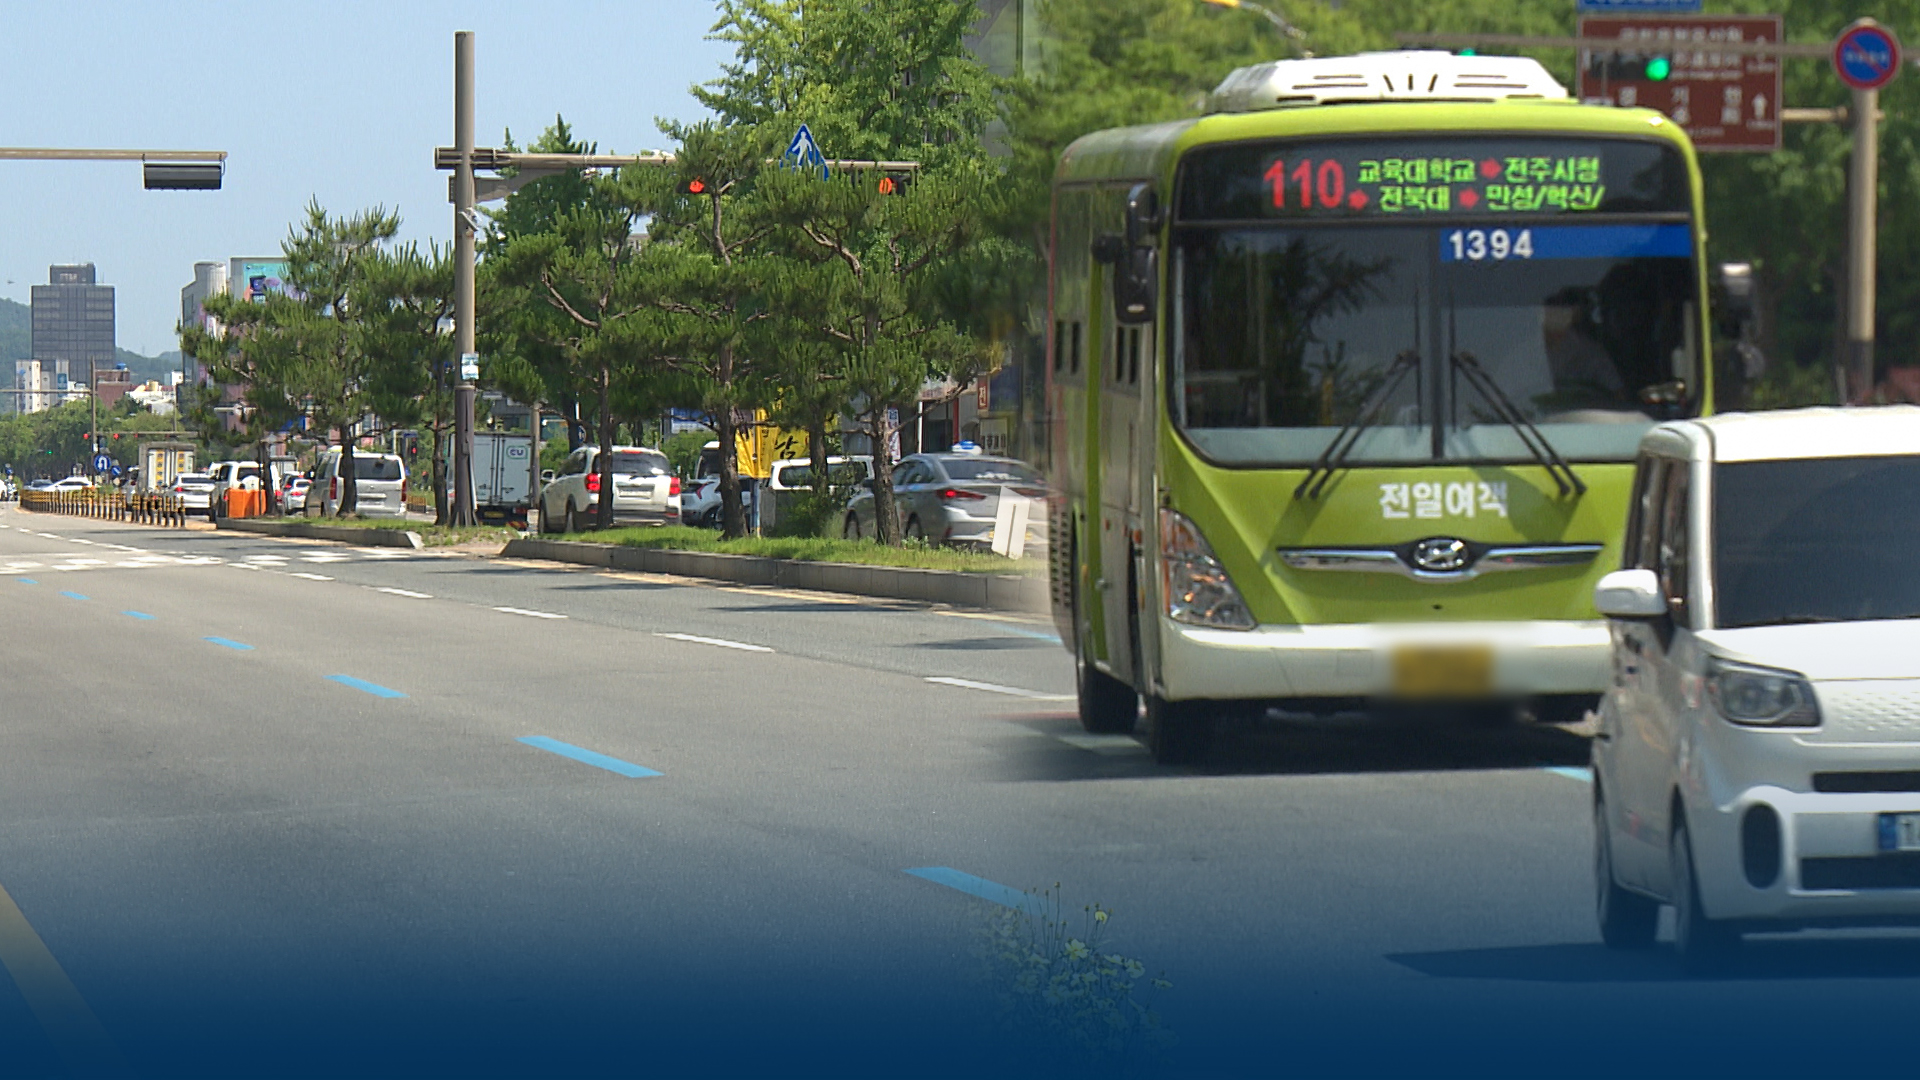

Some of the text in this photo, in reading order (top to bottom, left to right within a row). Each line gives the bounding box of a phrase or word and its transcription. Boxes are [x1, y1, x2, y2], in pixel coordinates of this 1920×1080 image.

[1264, 159, 1344, 208] 110
[1358, 157, 1601, 184] 교육대학교 전주시청
[1379, 185, 1451, 212] 전북대
[1449, 229, 1534, 260] 1394
[509, 448, 524, 456] CU
[1379, 481, 1509, 519] 전일여객
